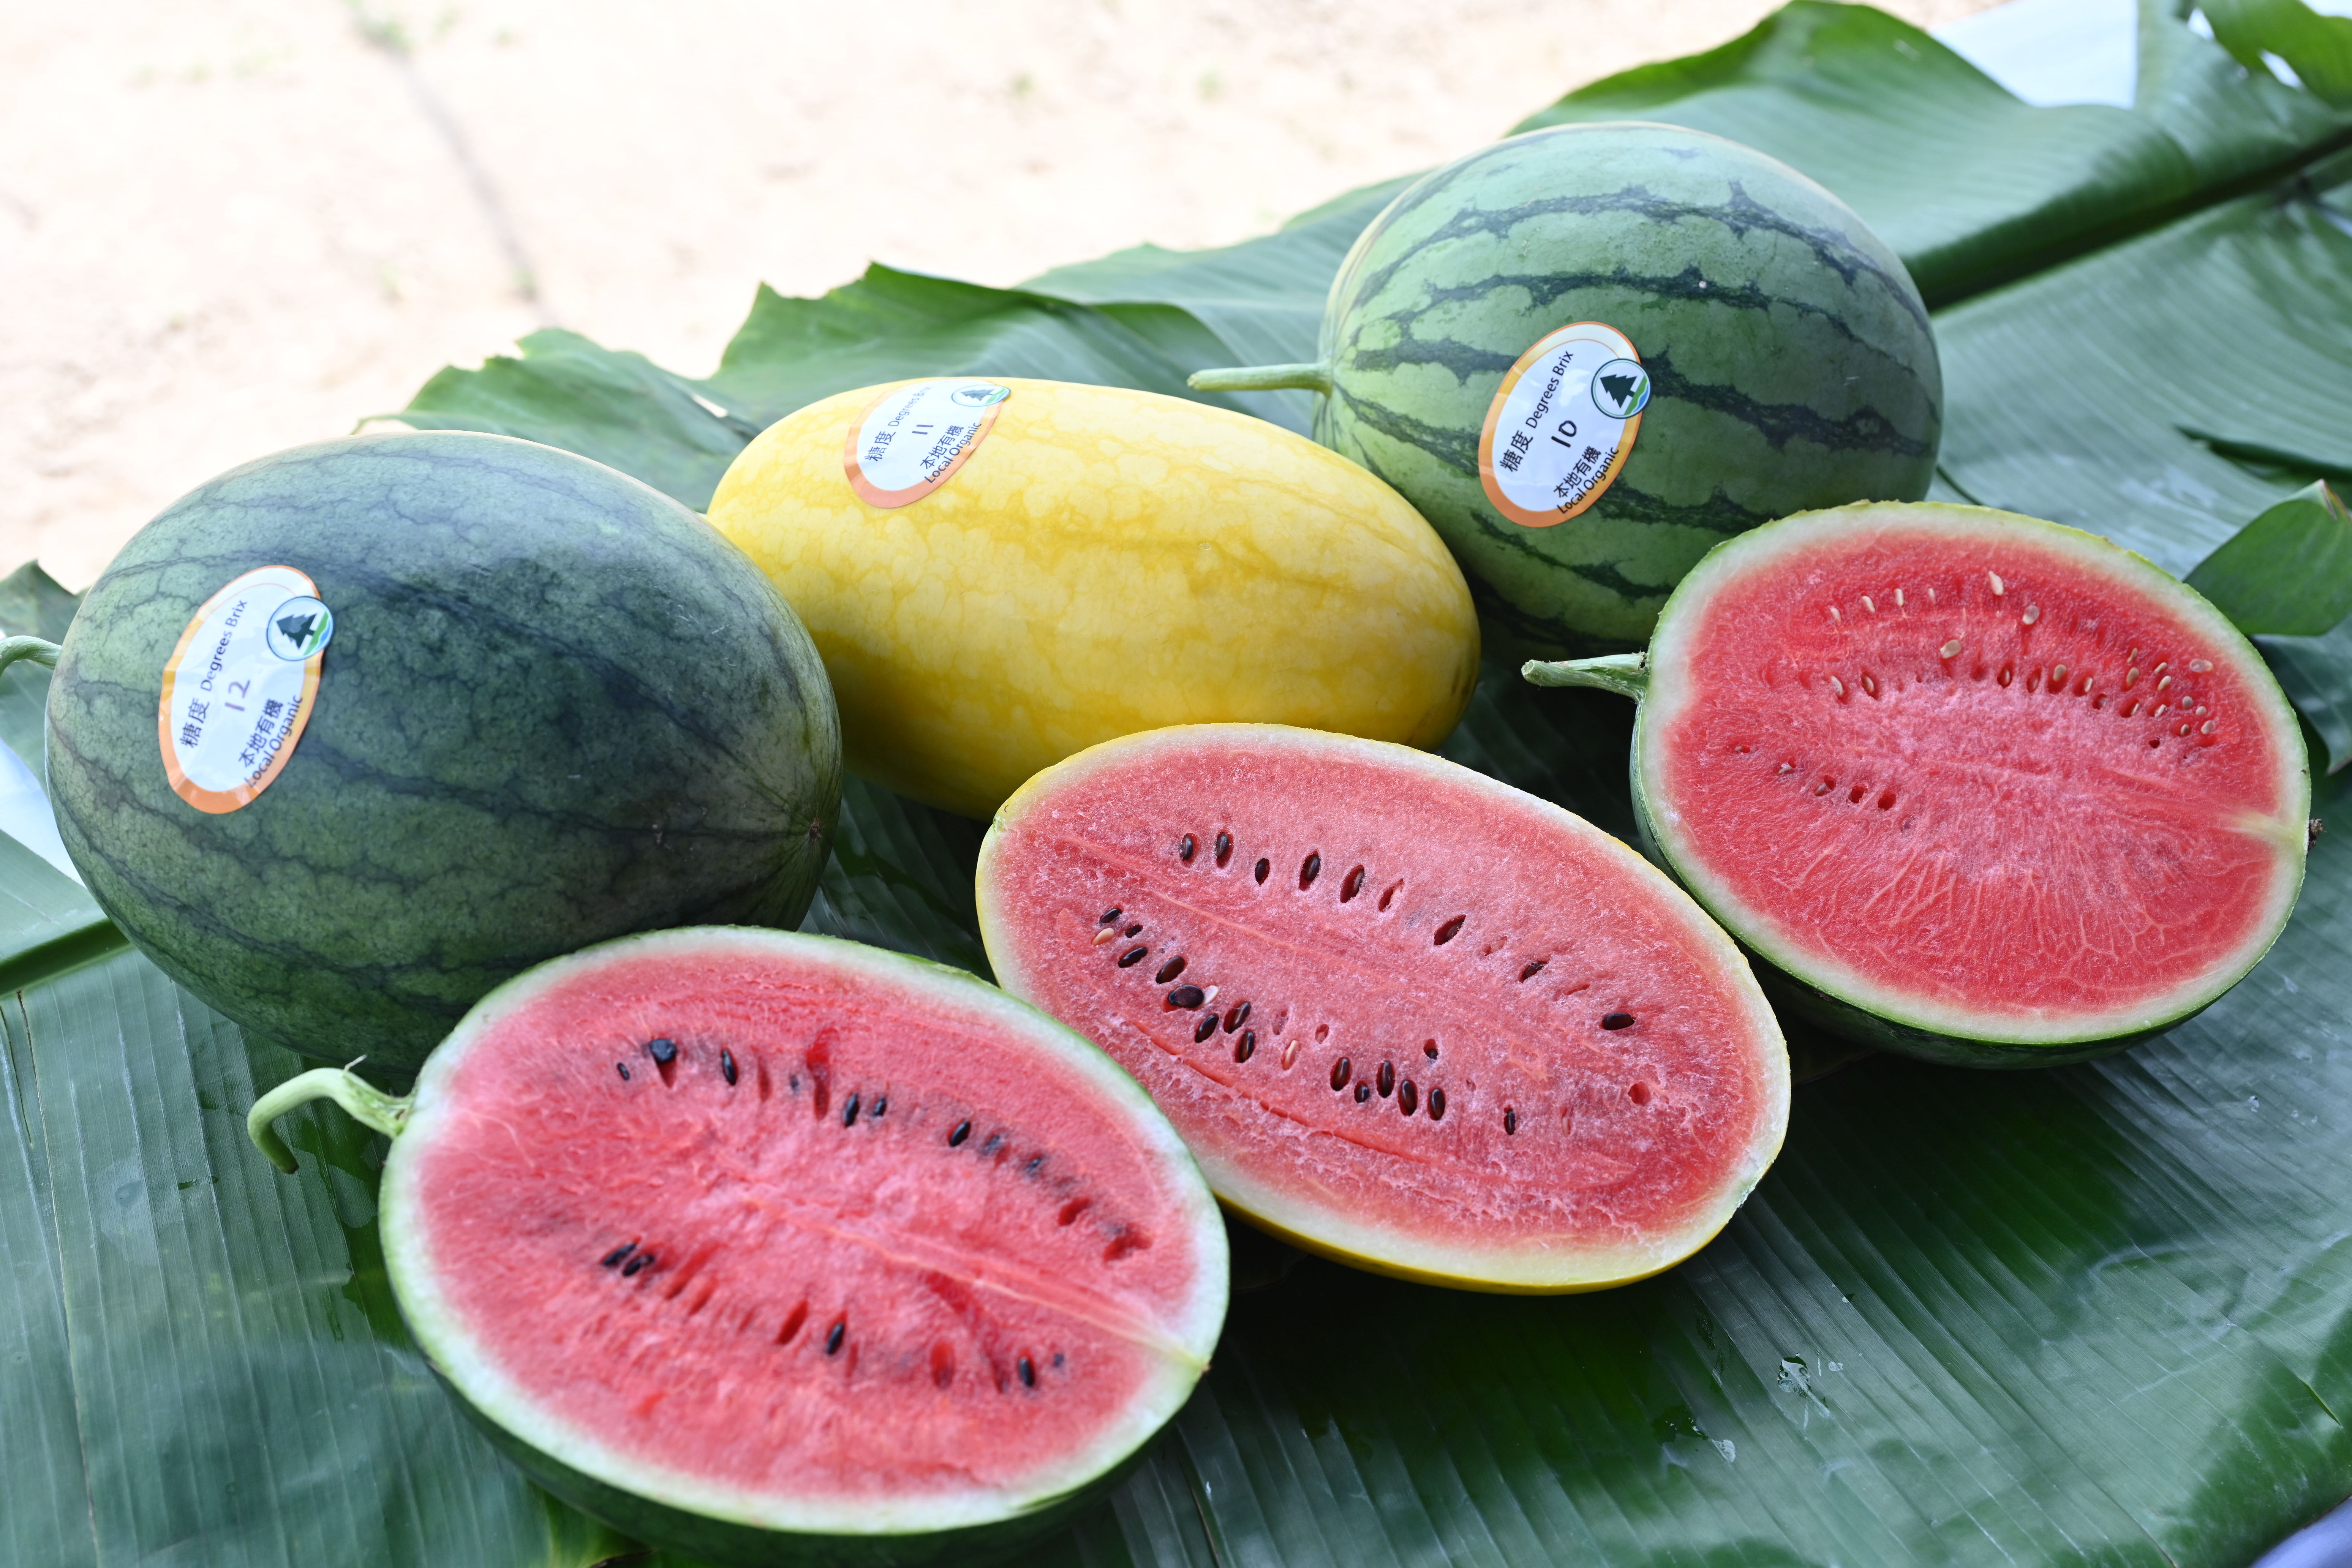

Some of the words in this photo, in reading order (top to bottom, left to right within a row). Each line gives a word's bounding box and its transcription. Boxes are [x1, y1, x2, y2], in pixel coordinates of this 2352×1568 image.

[864, 431, 896, 462] 糖度
[888, 398, 919, 426] Degrees
[912, 424, 934, 435] 11
[1500, 430, 1533, 472] 糖度
[1525, 378, 1559, 428] Degrees
[1553, 351, 1573, 375] Brix
[1551, 420, 1577, 447] 10
[920, 425, 964, 469] 本地有機
[924, 457, 953, 483] Local
[949, 422, 982, 456] Organic
[1554, 446, 1602, 498] 本地有機
[1557, 488, 1587, 514] Local
[1584, 447, 1619, 490] Organic
[180, 698, 209, 748] 糖度
[201, 630, 232, 691] Degrees
[226, 600, 247, 628] Brix
[224, 680, 250, 711] 12
[239, 699, 283, 767] 本地有機
[243, 750, 275, 787] Local
[269, 696, 303, 751] Organic
